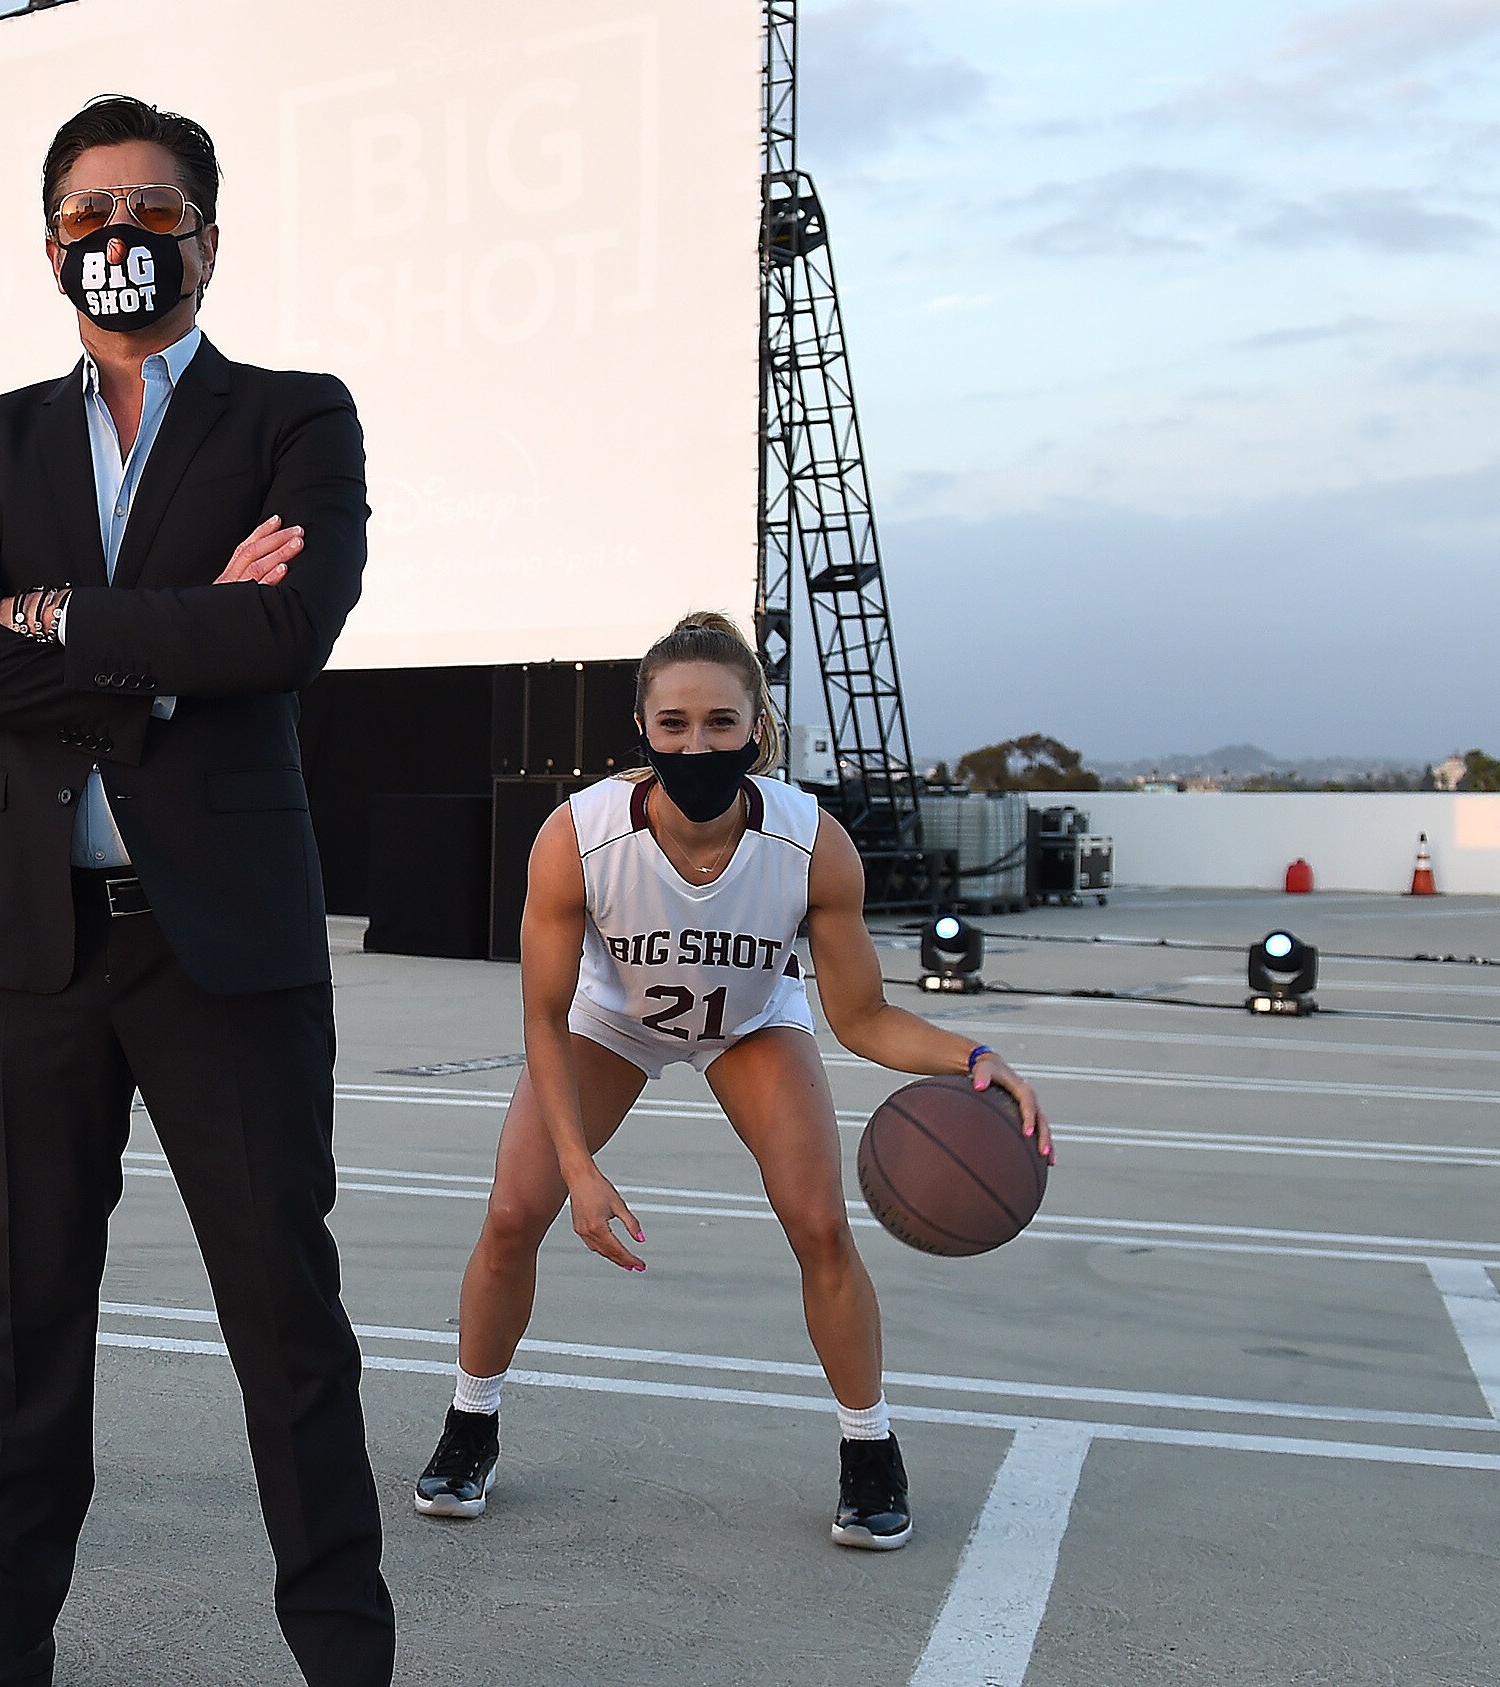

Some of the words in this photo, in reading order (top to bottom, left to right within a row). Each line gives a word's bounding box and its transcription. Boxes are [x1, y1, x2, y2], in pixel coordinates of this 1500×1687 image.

[351, 77, 584, 242] BIG
[81, 245, 155, 290] BIG
[85, 284, 157, 316] SHOT
[333, 229, 620, 367] SHOT
[551, 543, 606, 576] April
[607, 930, 670, 966] BIG
[678, 929, 783, 970] SHOT
[641, 984, 728, 1041] 21
